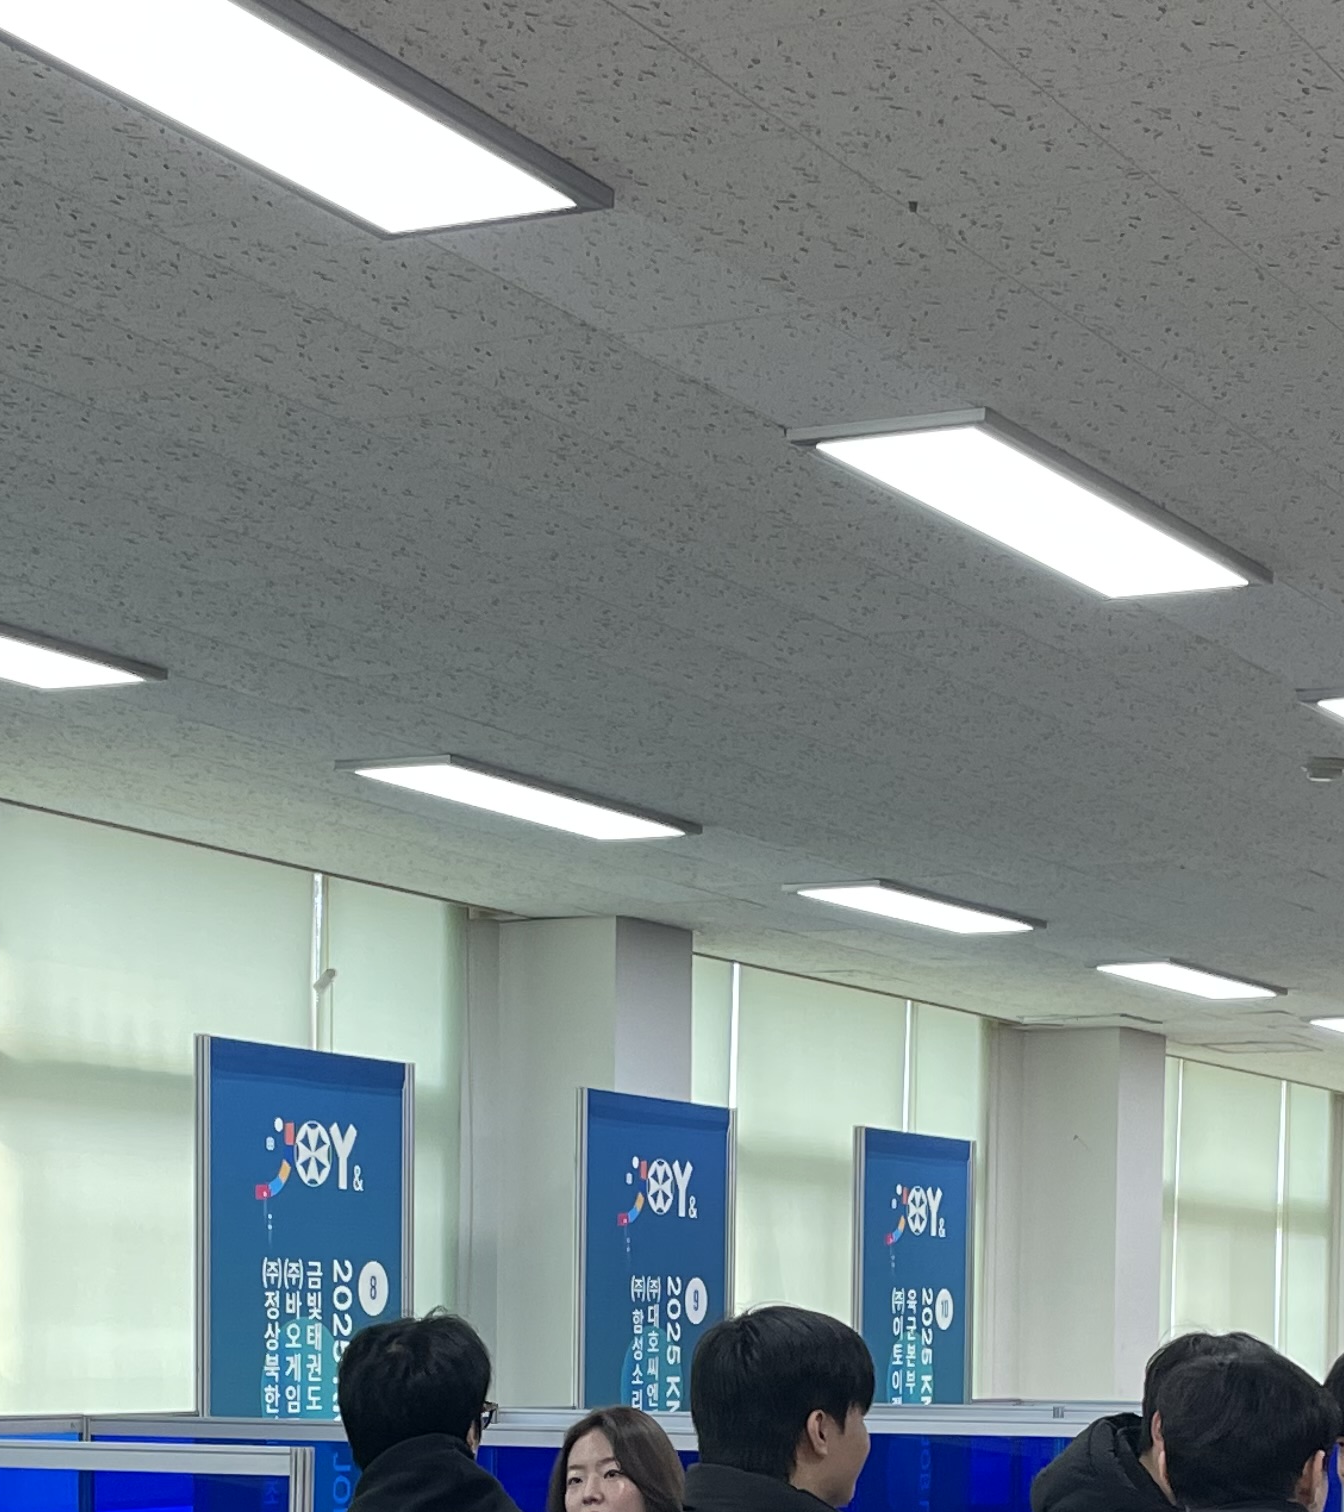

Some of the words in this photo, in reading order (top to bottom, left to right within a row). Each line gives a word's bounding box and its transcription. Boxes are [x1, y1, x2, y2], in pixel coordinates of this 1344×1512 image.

[370, 1275, 377, 1300] 8
[667, 1276, 681, 1364] 2025
[693, 1290, 699, 1311] 9
[921, 1287, 933, 1365] 2025
[940, 1300, 948, 1318] 10
[262, 1257, 282, 1420] (주)정상북한
[284, 1258, 304, 1420] (주)바오게임
[306, 1261, 323, 1410] 금빛태권도
